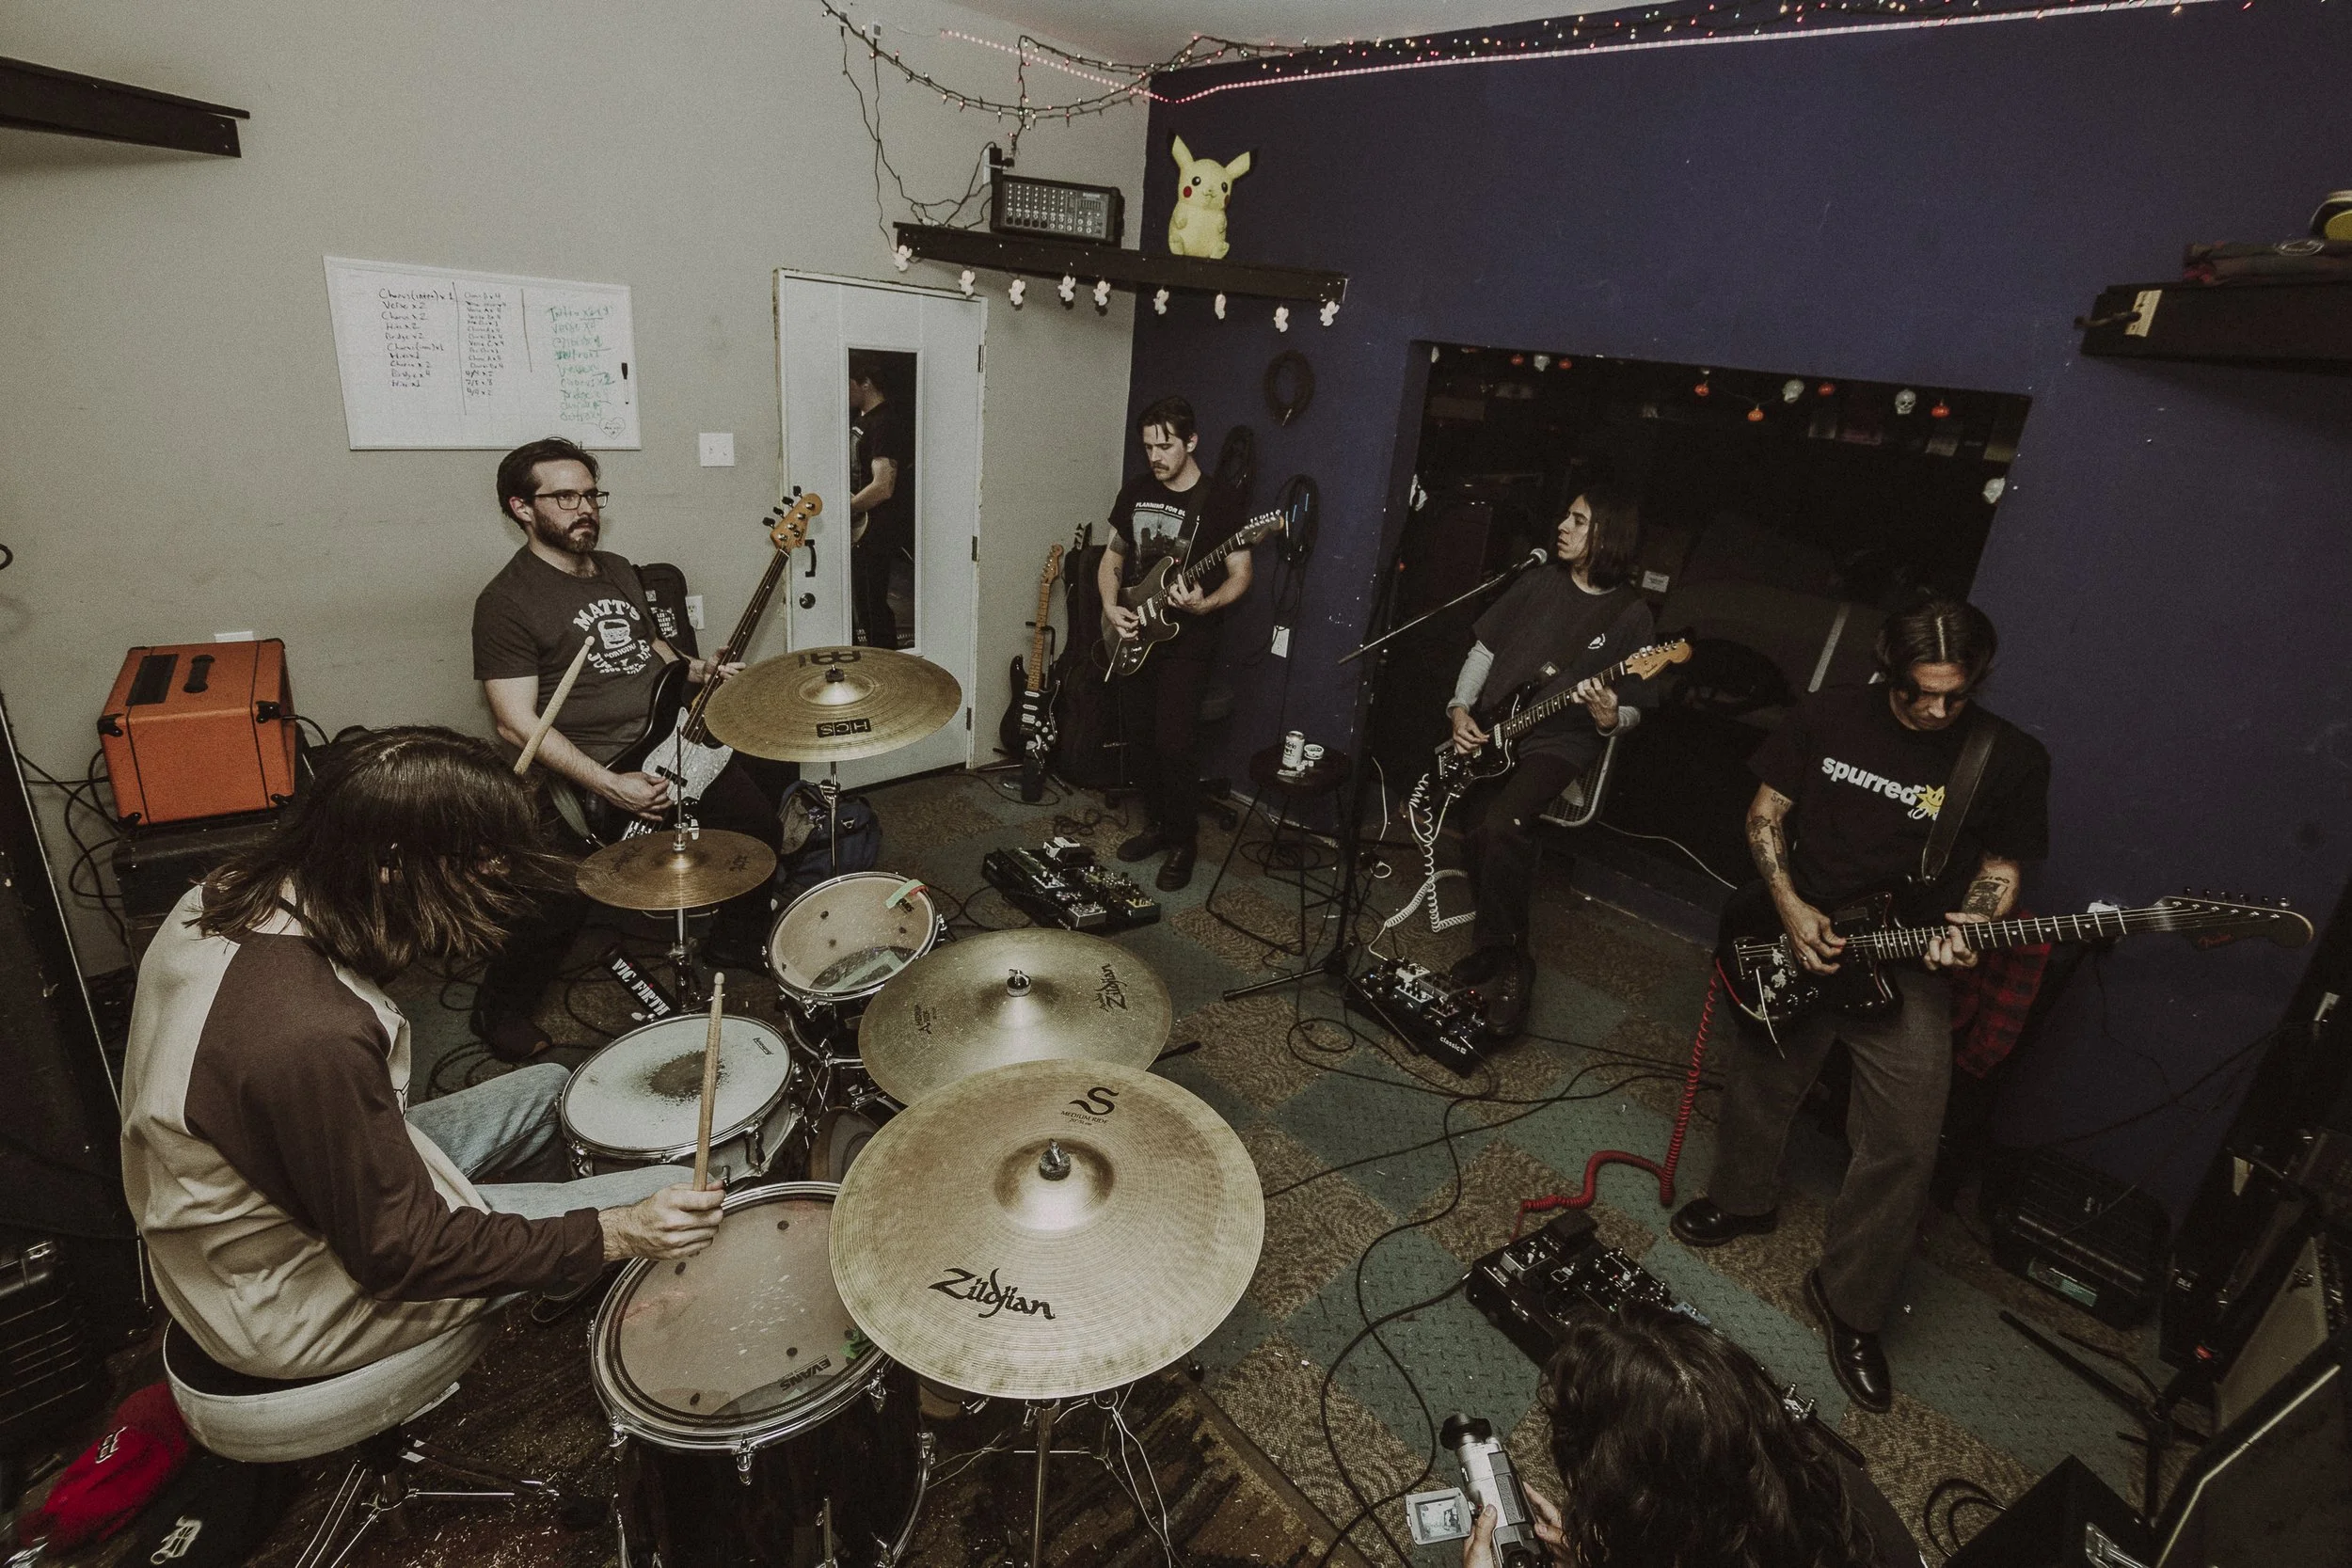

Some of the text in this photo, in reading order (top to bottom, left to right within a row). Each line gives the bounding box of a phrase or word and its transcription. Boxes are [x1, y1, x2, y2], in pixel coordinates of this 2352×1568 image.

[573, 599, 641, 631] MATT'S
[818, 720, 870, 737] HCS
[1821, 757, 1921, 806] spurred
[612, 958, 671, 1018] VIC FIRTH
[1094, 963, 1128, 1012] Zildjian
[1439, 1036, 1461, 1052] classic
[1060, 1110, 1091, 1122] MEDIUM
[1068, 1086, 1120, 1116] S
[929, 1267, 1056, 1321] Zildjian
[779, 1357, 832, 1391] EVANS
